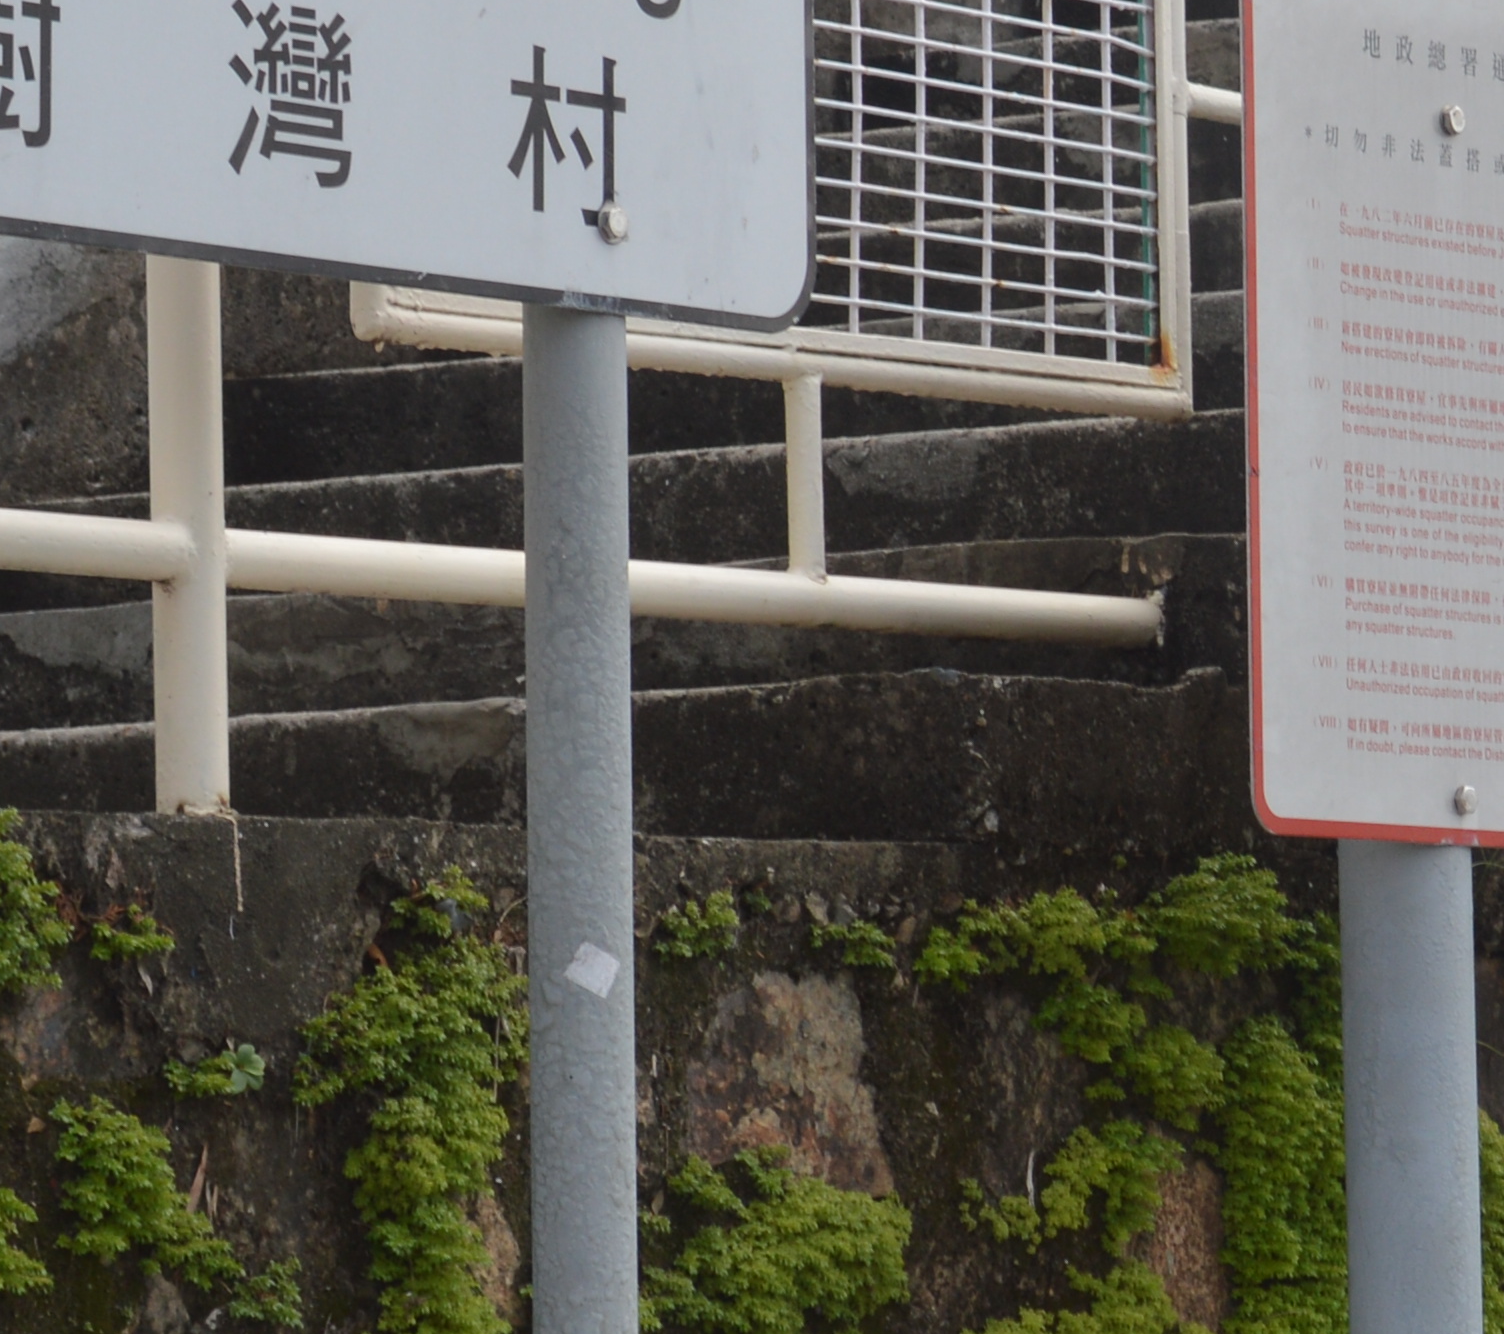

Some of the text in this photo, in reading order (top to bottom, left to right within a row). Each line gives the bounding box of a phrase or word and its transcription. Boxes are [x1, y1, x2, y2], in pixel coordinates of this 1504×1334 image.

[1339, 221, 1379, 243] Squatter
[1381, 229, 1429, 248] structures
[1430, 236, 1465, 254] existed
[1466, 241, 1496, 259] before
[1340, 281, 1377, 302] Change
[1389, 288, 1405, 303] the
[1406, 294, 1424, 306] use
[1437, 295, 1497, 316] unauthorized
[1341, 341, 1362, 356] New
[1363, 344, 1408, 362] erections
[1421, 352, 1459, 372] squatter
[1341, 399, 1390, 419] Residents
[1391, 409, 1407, 421] are
[1409, 408, 1446, 426] advised
[1458, 415, 1492, 432] contact
[1353, 424, 1386, 438] ensure
[1388, 425, 1407, 441] that
[1408, 428, 1424, 443] the
[1425, 430, 1453, 446] works
[1454, 434, 1486, 450] accord
[1352, 498, 1416, 521] territory-wide
[1418, 507, 1457, 526] squatter
[1343, 518, 1361, 532] this
[1364, 523, 1396, 539] survey
[1410, 528, 1429, 540] one
[1444, 529, 1459, 543] the
[1461, 531, 1502, 551] eligibility
[1344, 538, 1374, 554] confer
[1376, 545, 1393, 559] any
[1395, 543, 1417, 561] right
[1430, 547, 1469, 567] anybody
[1471, 551, 1484, 565] for
[1485, 553, 1500, 567] the
[1344, 597, 1390, 614] Purchase
[1403, 603, 1443, 622] squatter
[1444, 607, 1491, 624] structures
[1345, 621, 1362, 635] any
[1364, 620, 1404, 639] squatter
[1346, 677, 1410, 695] Unauthorized
[1411, 683, 1463, 703] occupation
[1397, 740, 1430, 759] please
[1431, 744, 1466, 758] contact
[1467, 746, 1482, 760] the
